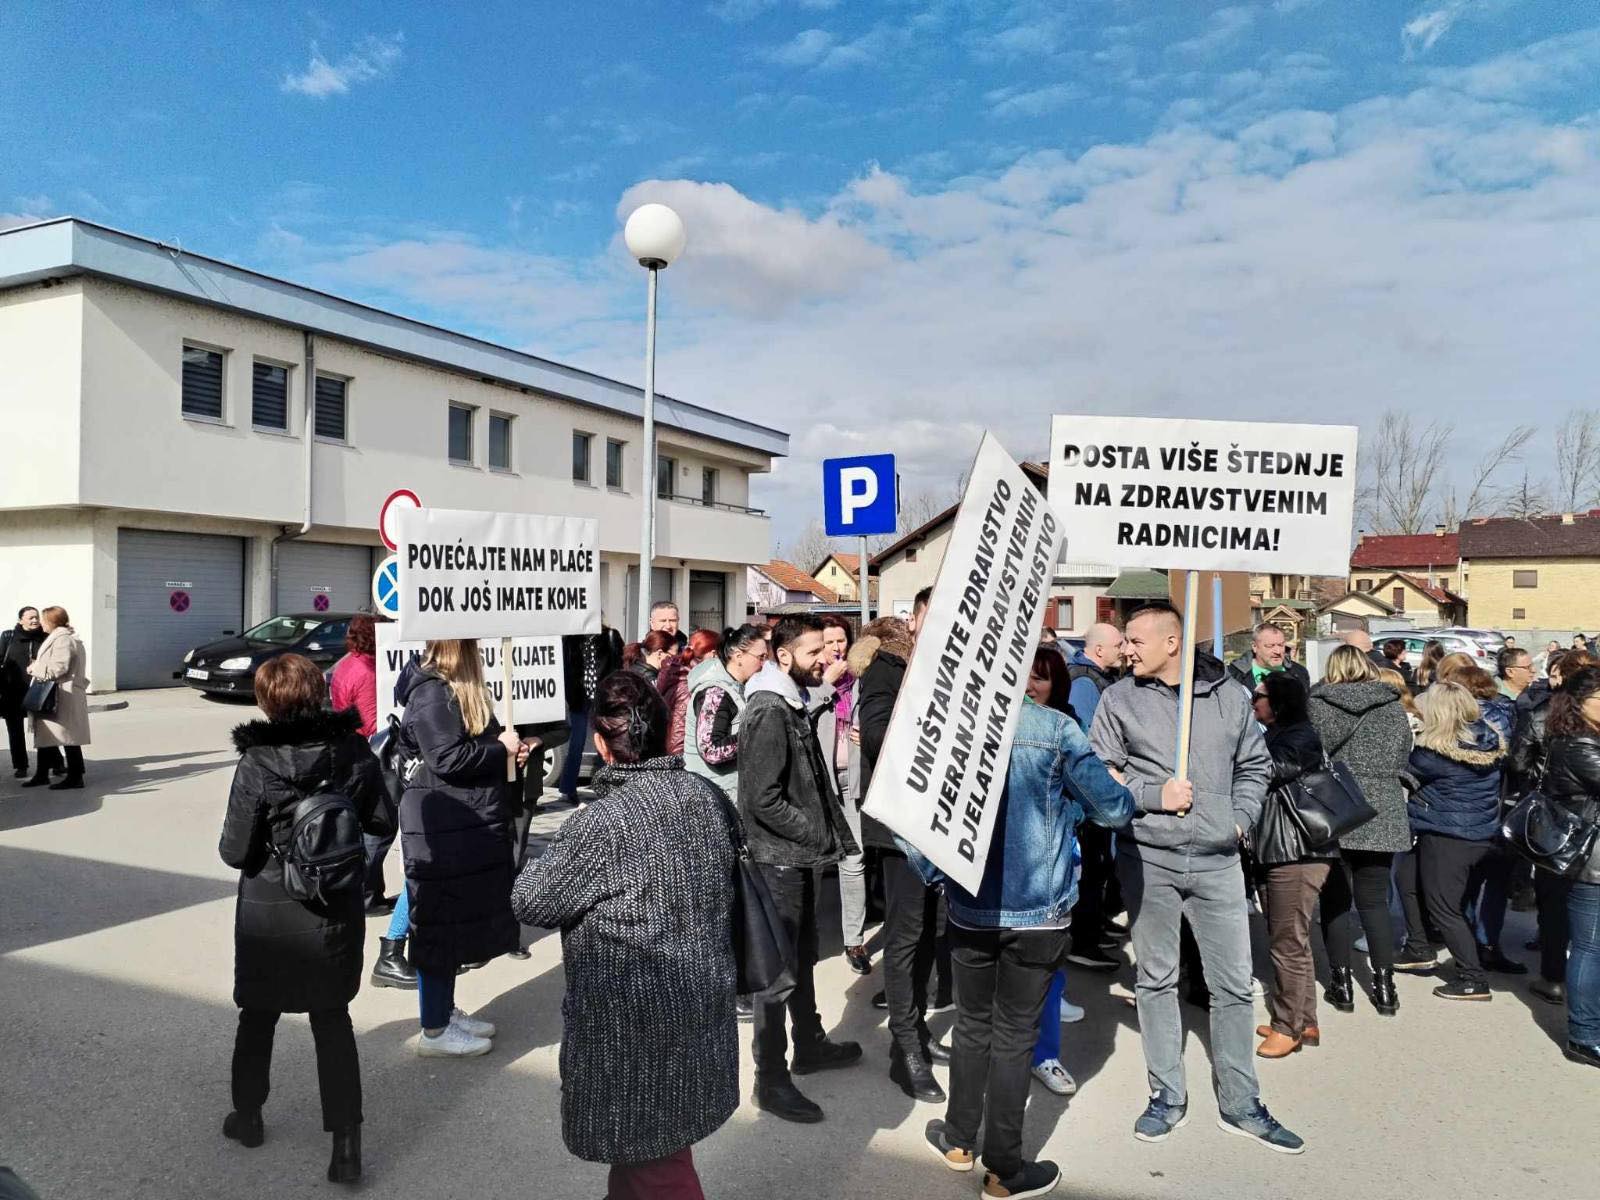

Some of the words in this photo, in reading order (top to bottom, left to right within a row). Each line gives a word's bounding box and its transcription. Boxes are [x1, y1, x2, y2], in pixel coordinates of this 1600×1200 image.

[1064, 444, 1150, 470] DOSTA
[1160, 441, 1219, 473] VIŠE
[1227, 442, 1344, 478] ŠTEDNJE
[840, 466, 878, 524] P
[1075, 482, 1112, 507] NA
[1119, 484, 1327, 516] ZDRAVSTVENIM
[408, 537, 507, 572] POVEĆAJTE
[511, 547, 546, 572] NAM
[550, 544, 593, 573] PLAĆE
[1117, 521, 1281, 552] RADNICIMA!
[419, 586, 455, 613] DOK
[461, 580, 492, 612] JOŠ
[497, 586, 543, 611] IMATE
[548, 587, 587, 611] KOME
[1008, 512, 1056, 664] INOZEMSTVO
[906, 621, 970, 793] UNIŠTAVATE
[959, 479, 1011, 624] ZDRAVSTVO
[931, 669, 986, 836] TJERANJEM
[976, 487, 1037, 672] ZDRAVSTVENIH
[1002, 663, 1018, 688] U
[957, 692, 1011, 863] DJELATNIKA
